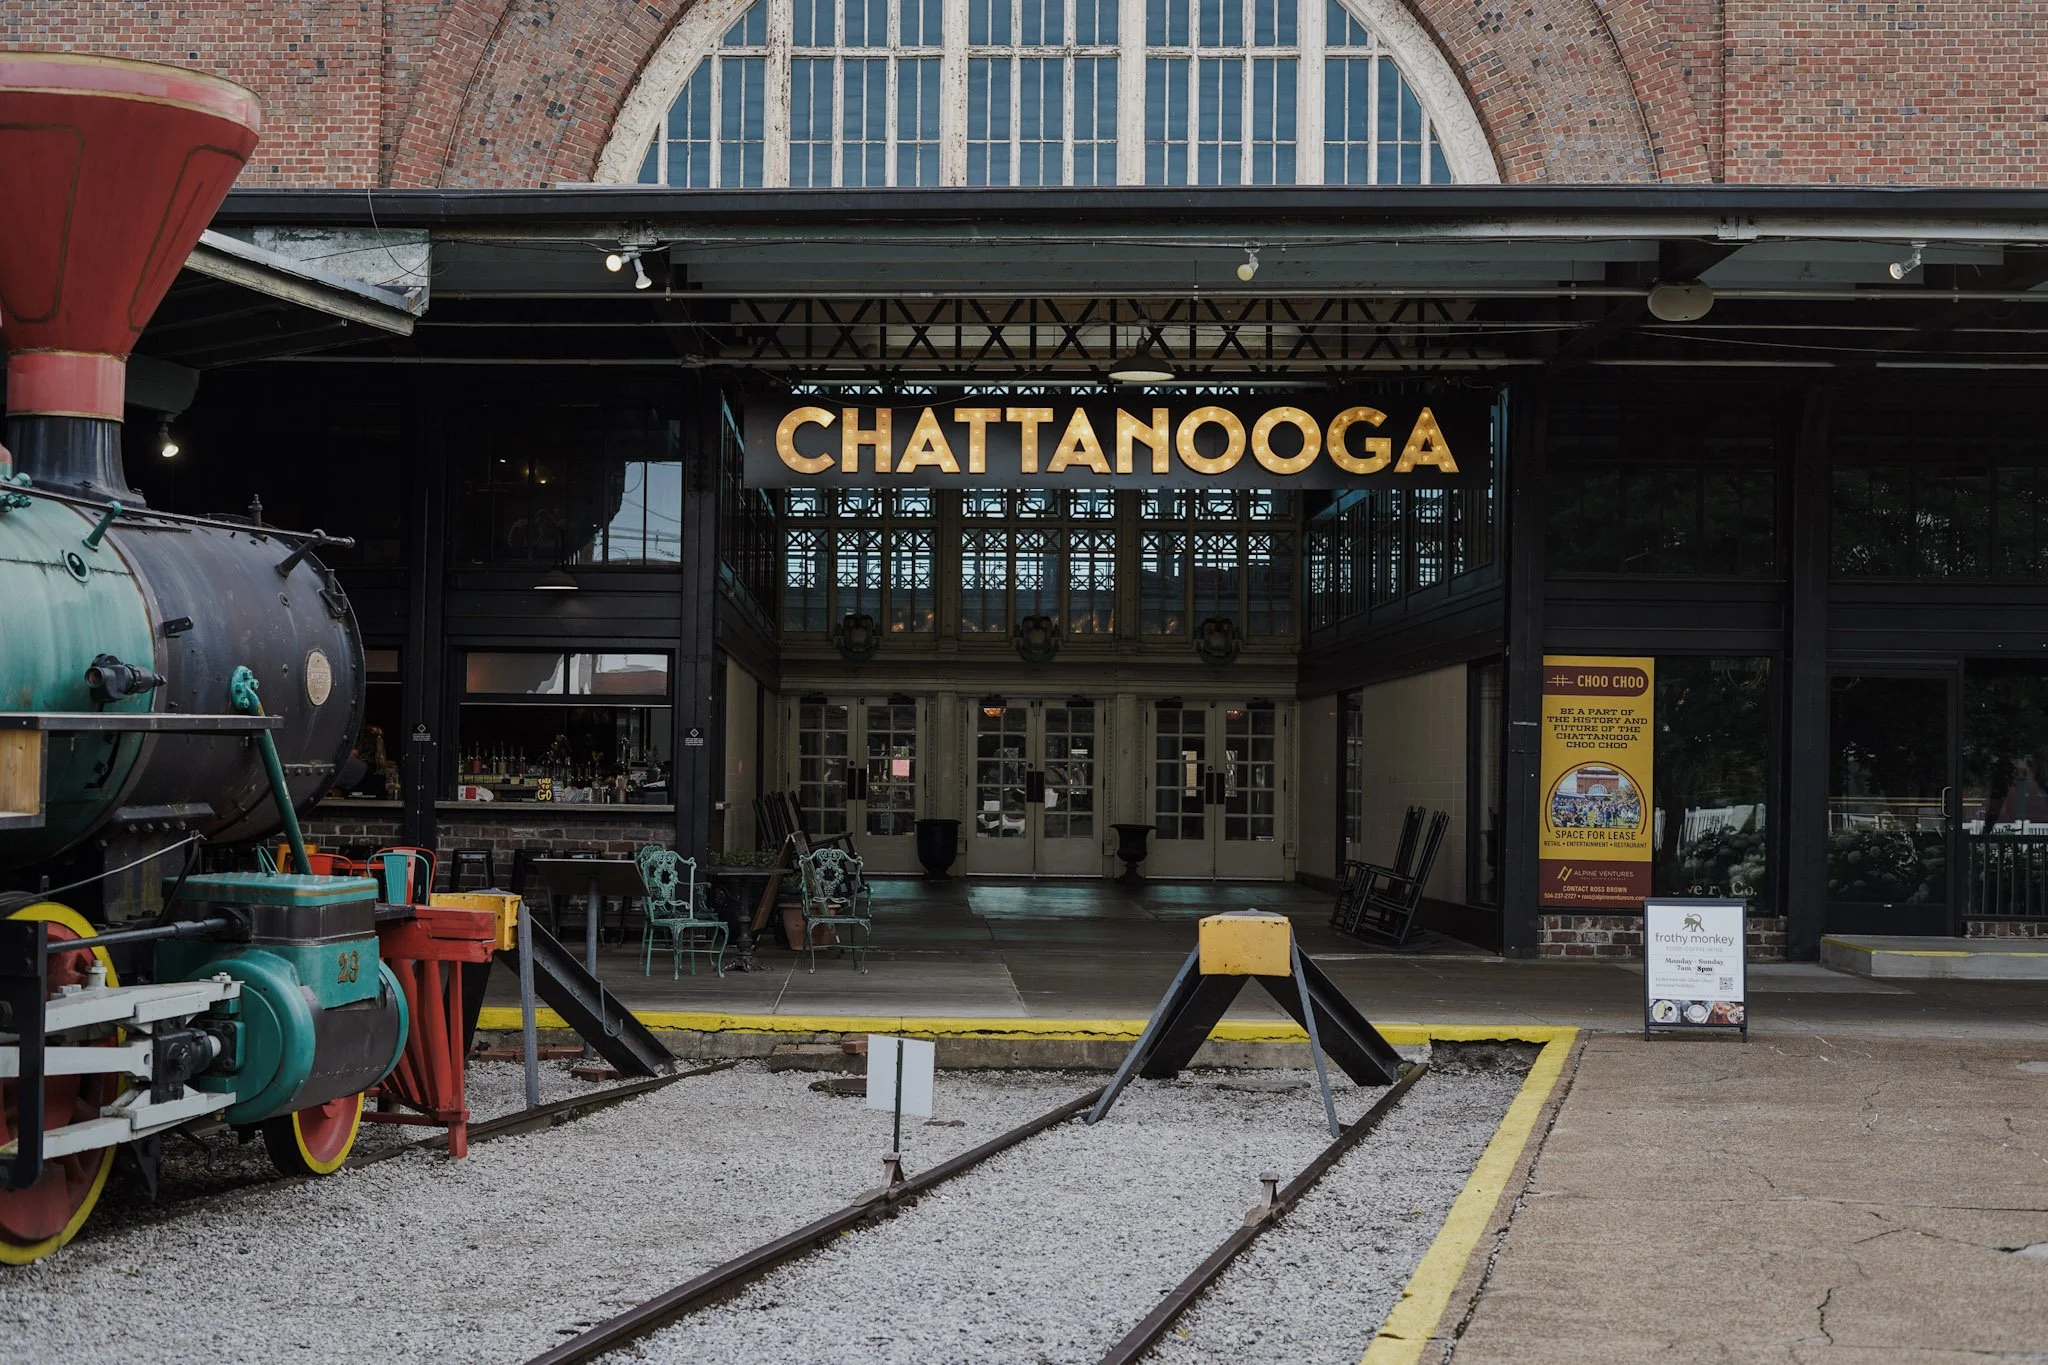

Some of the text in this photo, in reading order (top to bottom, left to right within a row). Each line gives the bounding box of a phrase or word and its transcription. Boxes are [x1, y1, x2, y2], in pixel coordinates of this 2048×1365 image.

[775, 405, 1459, 475] CHATTANOOGA
[1577, 675, 1644, 688] CHOO CHOO
[1556, 733, 1638, 741] CHATTANOOGA
[537, 789, 552, 801] GO
[1555, 830, 1636, 840] SPACE FOR LEASE
[1731, 880, 1757, 895] Co.
[1655, 932, 1735, 946] frothy monkey
[337, 950, 358, 984] 29
[1698, 958, 1724, 966] Sunday
[1697, 965, 1713, 973] 8pm
